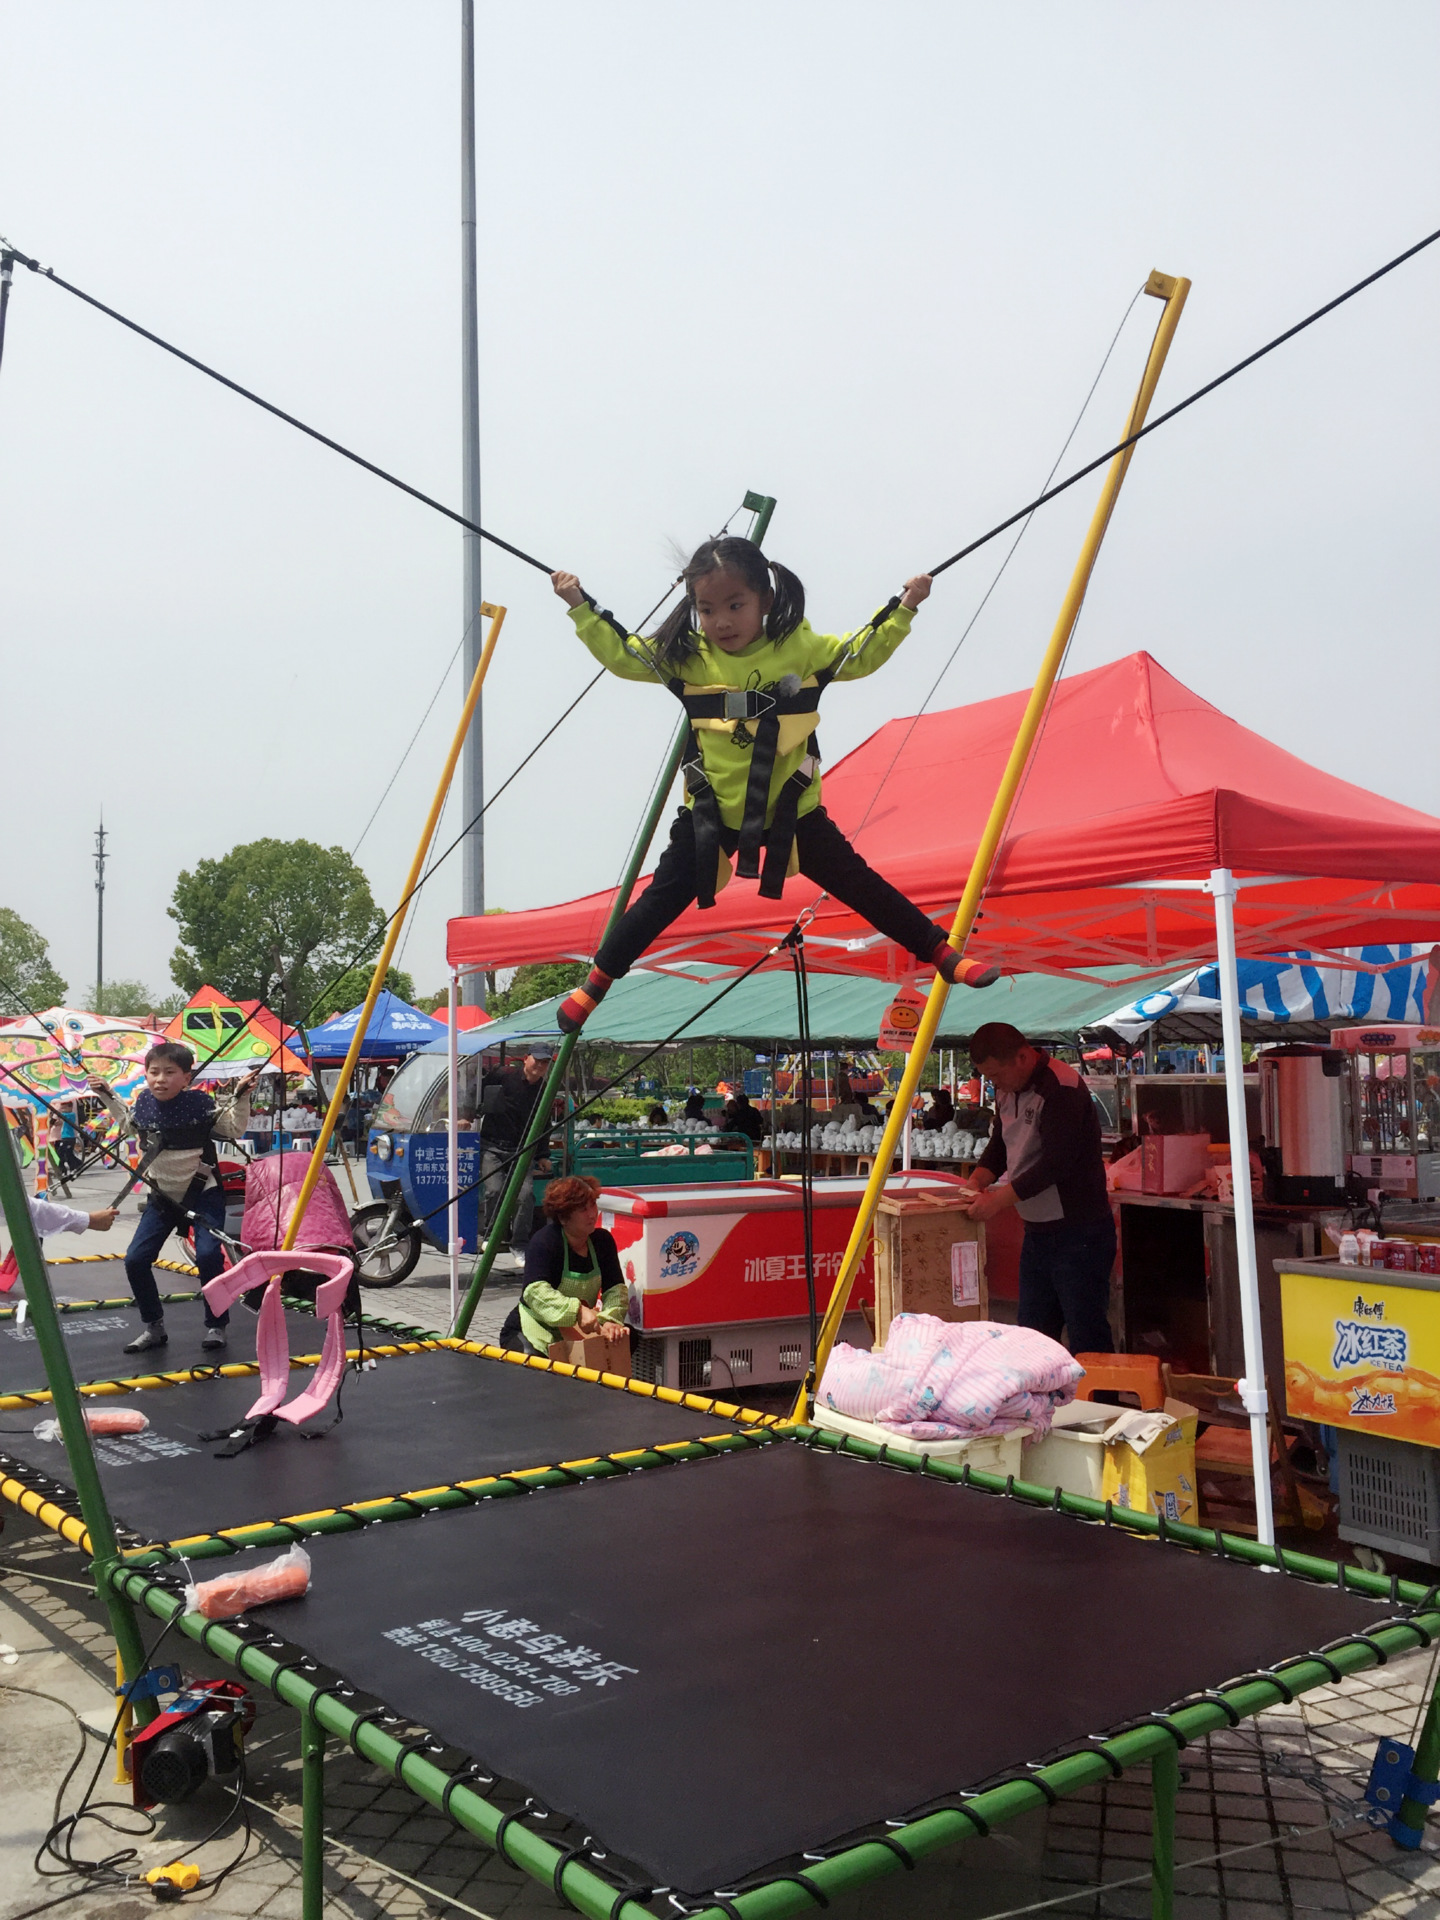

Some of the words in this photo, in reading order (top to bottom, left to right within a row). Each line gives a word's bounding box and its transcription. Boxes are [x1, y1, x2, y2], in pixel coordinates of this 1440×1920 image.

[1334, 1321, 1405, 1368] 冰红茶
[1383, 1361, 1404, 1373] TEA
[450, 1635, 581, 1696] 400-0234-788
[461, 1609, 639, 1686] 小憨鸟游乐
